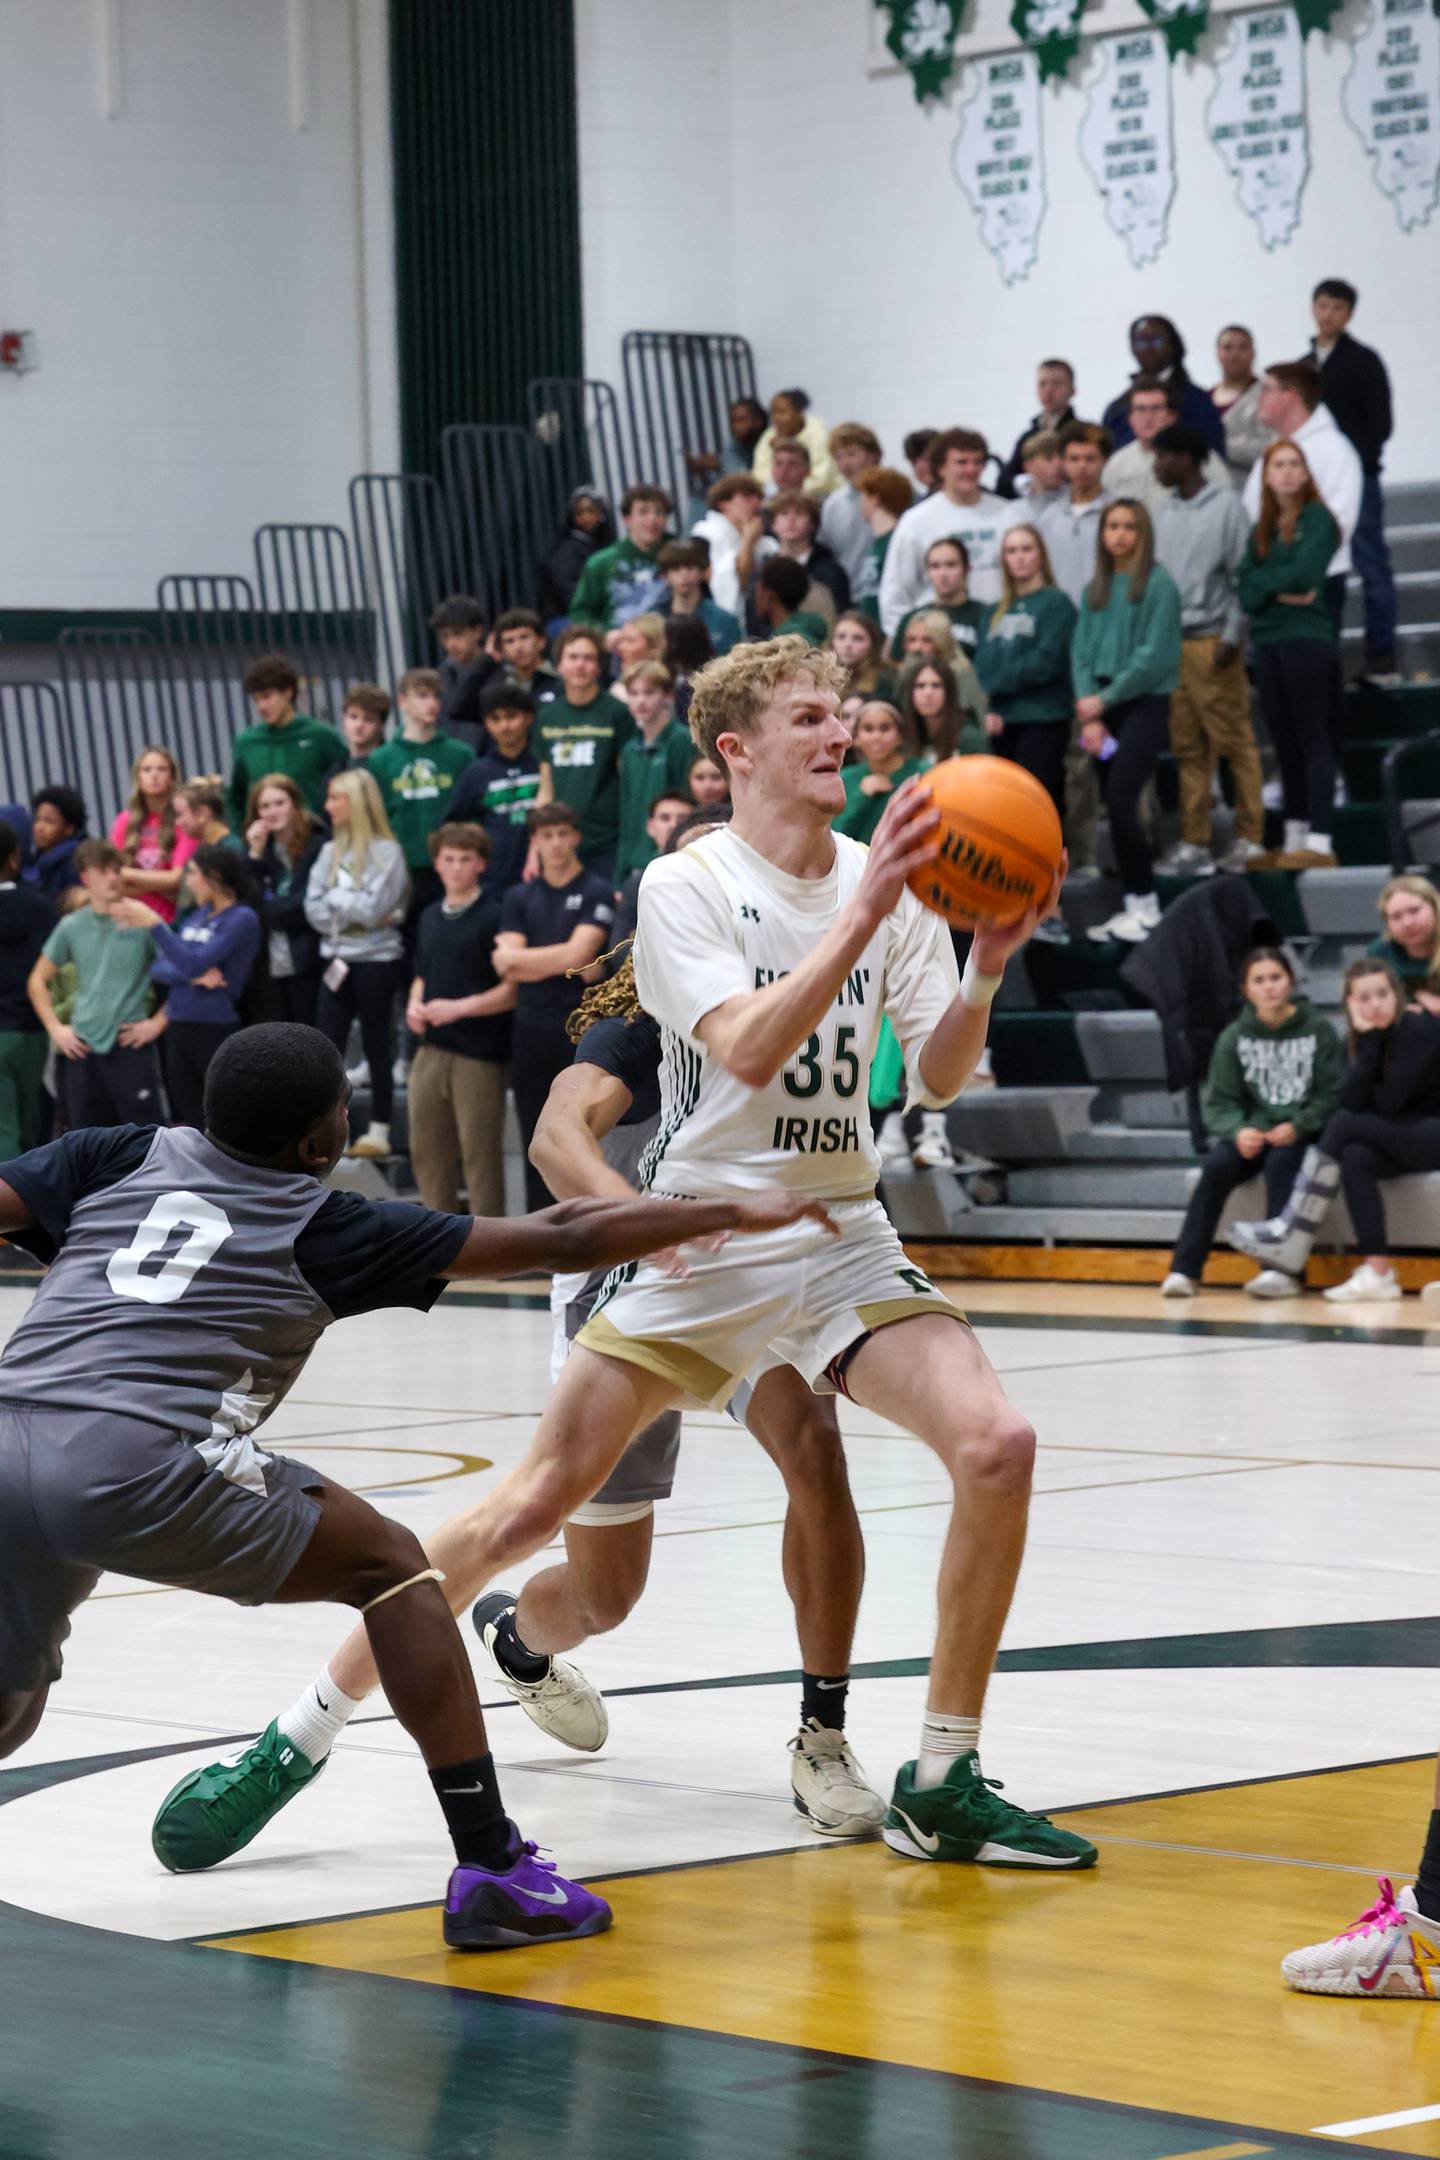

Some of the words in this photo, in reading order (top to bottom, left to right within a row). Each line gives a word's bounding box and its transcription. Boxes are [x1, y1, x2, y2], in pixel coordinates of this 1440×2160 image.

[781, 1025, 860, 1099] 35
[773, 1116, 859, 1153] IRISH
[106, 1191, 234, 1304] 0
